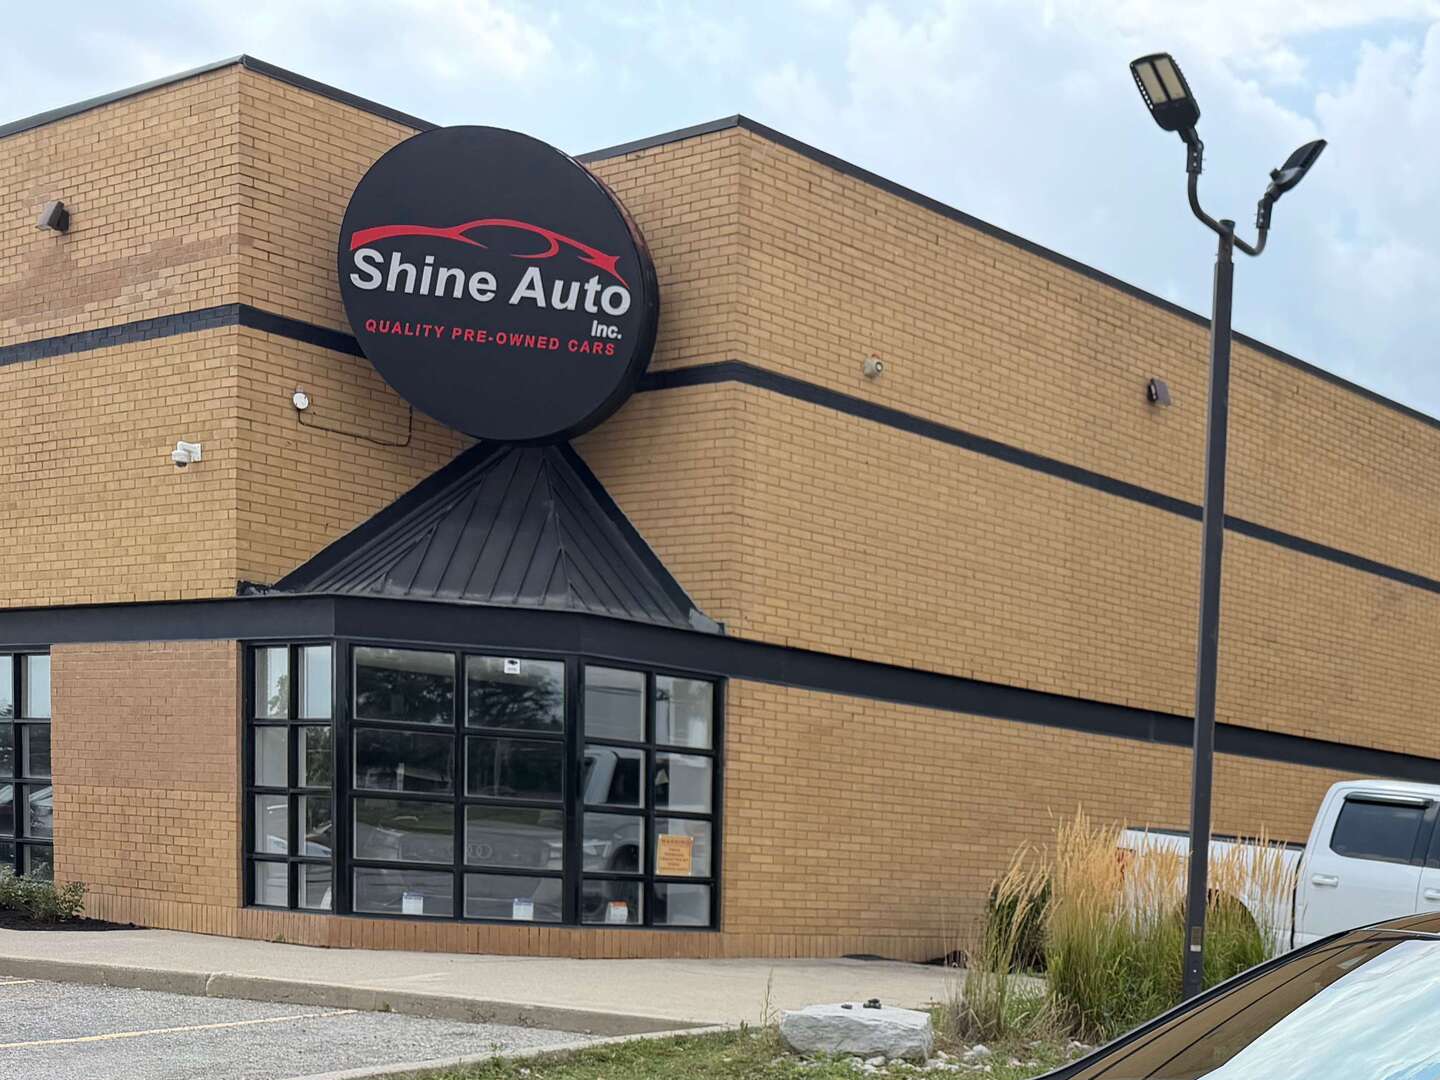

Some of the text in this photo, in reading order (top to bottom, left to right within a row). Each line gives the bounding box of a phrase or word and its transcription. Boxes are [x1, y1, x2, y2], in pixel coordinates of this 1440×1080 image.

[350, 248, 631, 316] Shine Auto
[365, 319, 615, 356] QUALITY PRE-OWNED CARS
[591, 321, 622, 340] Inc.
